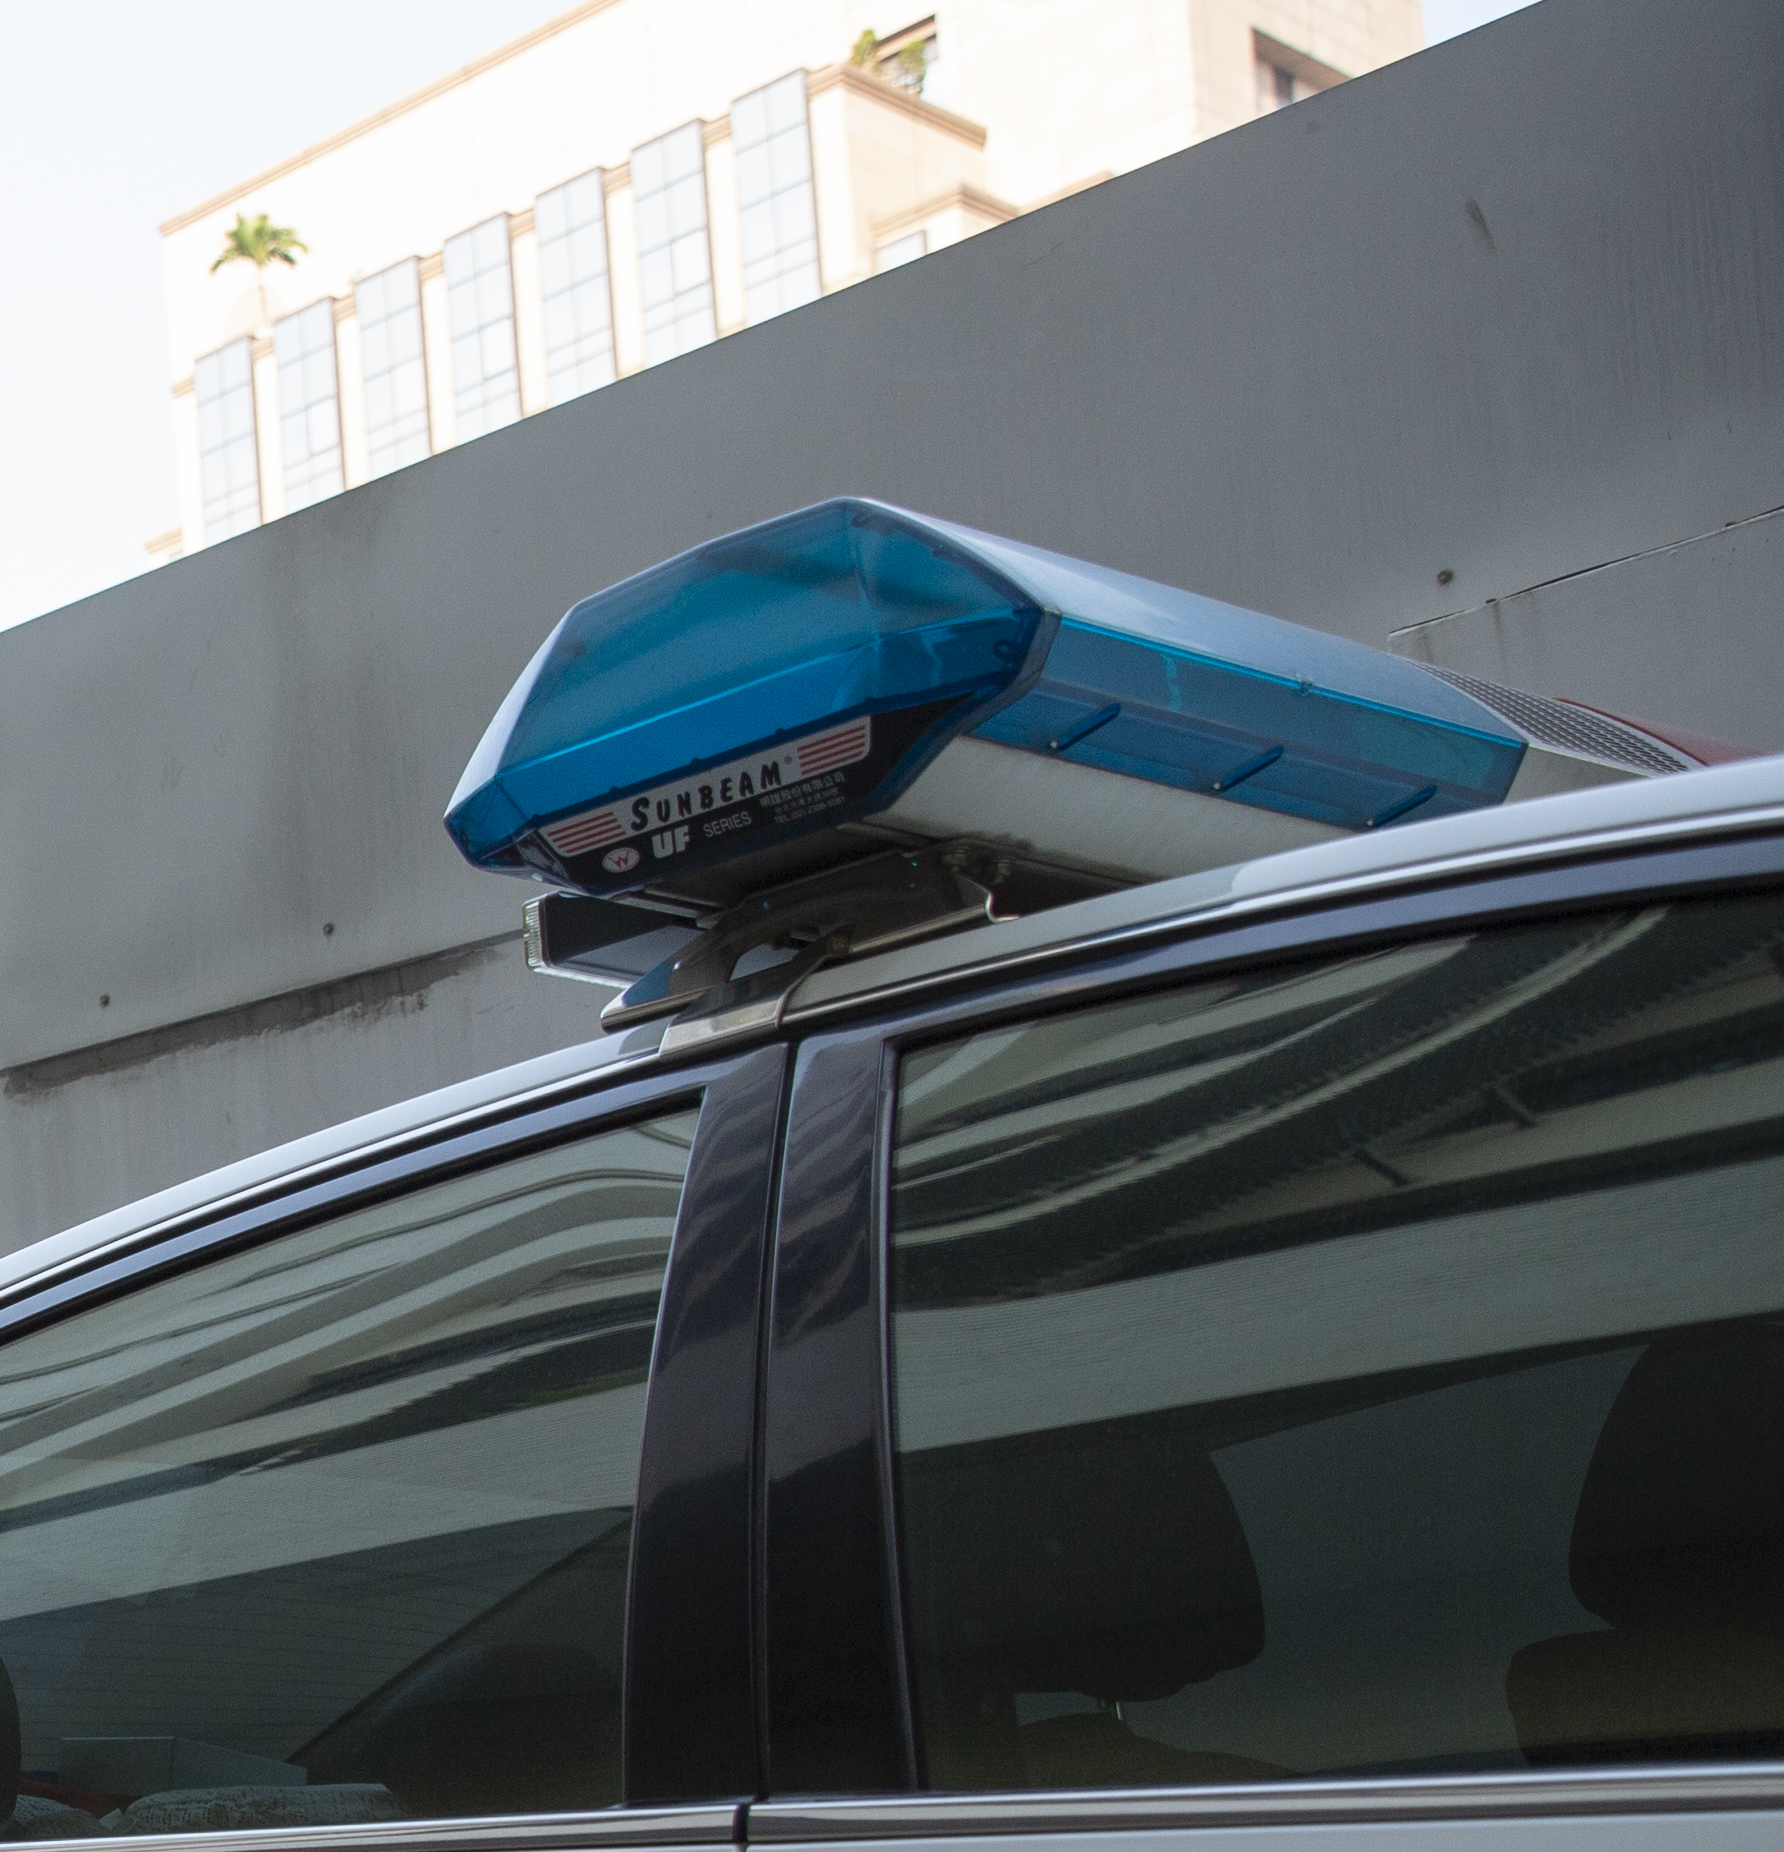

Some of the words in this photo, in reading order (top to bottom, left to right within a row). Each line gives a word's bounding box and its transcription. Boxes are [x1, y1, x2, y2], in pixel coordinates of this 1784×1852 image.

[631, 760, 782, 832] SUNBEAM
[652, 825, 690, 859] UF
[703, 811, 752, 838] SERIES
